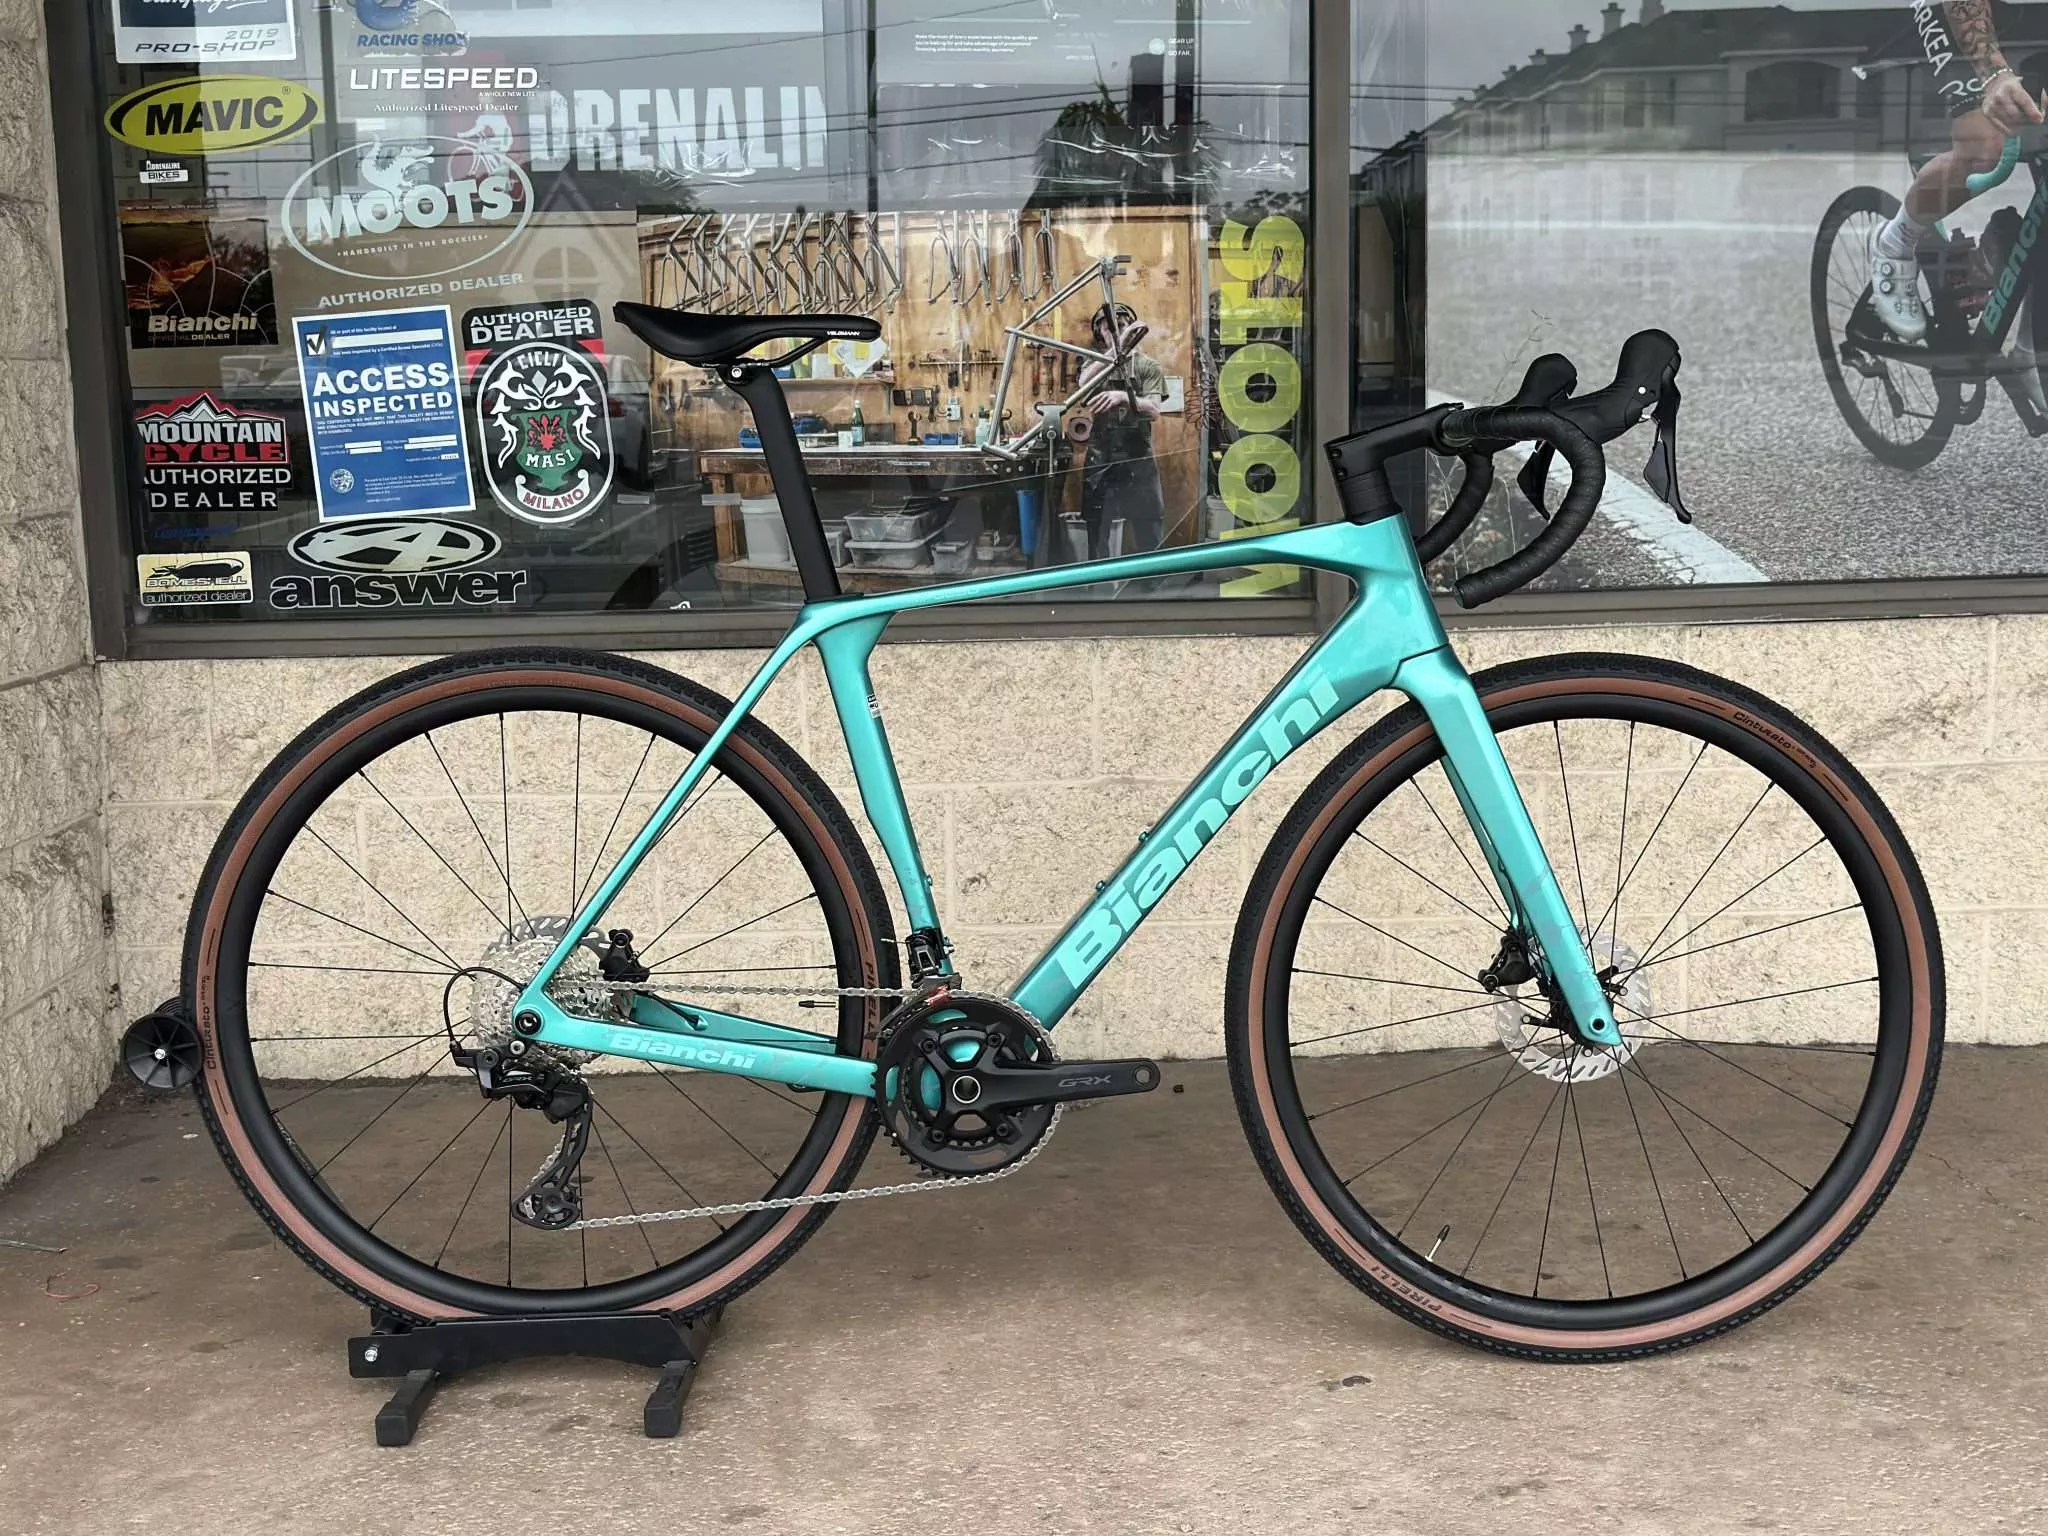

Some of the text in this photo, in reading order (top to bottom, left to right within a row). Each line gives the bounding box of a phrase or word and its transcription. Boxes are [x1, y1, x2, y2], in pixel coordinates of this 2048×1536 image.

[225, 28, 279, 40] 2019
[357, 34, 419, 47] RACING
[135, 40, 276, 53] PRO-SHOP
[350, 68, 539, 90] LITESPEED
[145, 96, 284, 136] MAVIC
[374, 103, 519, 112] Authorized Litespeed Dealer
[149, 171, 180, 179] BIKES
[306, 175, 513, 243] MOOTS
[403, 241, 414, 249] IN
[419, 239, 436, 247] THE
[318, 273, 525, 308] AUTHORIZED DEALER
[148, 312, 258, 332] Bianchi
[470, 306, 592, 327] AUTHORIZED
[471, 317, 595, 344] DEALER
[517, 351, 559, 370] CICLI
[313, 362, 450, 396] ACCESS
[313, 392, 452, 417] INSPECTED
[137, 422, 282, 443] MOUNTAIN
[144, 443, 282, 462] CYCLE
[525, 449, 575, 468] MASI
[151, 492, 277, 507] DEALER
[523, 488, 584, 510] MILANO
[146, 576, 247, 587] BOMBSHELL
[270, 570, 527, 609] answer
[146, 590, 247, 603] authorized dealer
[1733, 711, 1791, 749] Cinturato
[1056, 668, 1340, 989] Bianchi
[202, 1004, 216, 1069] Cinturato
[610, 1033, 756, 1068] Bianchi
[1058, 1075, 1112, 1087] GRX
[1370, 1265, 1443, 1312] PIRELLI
